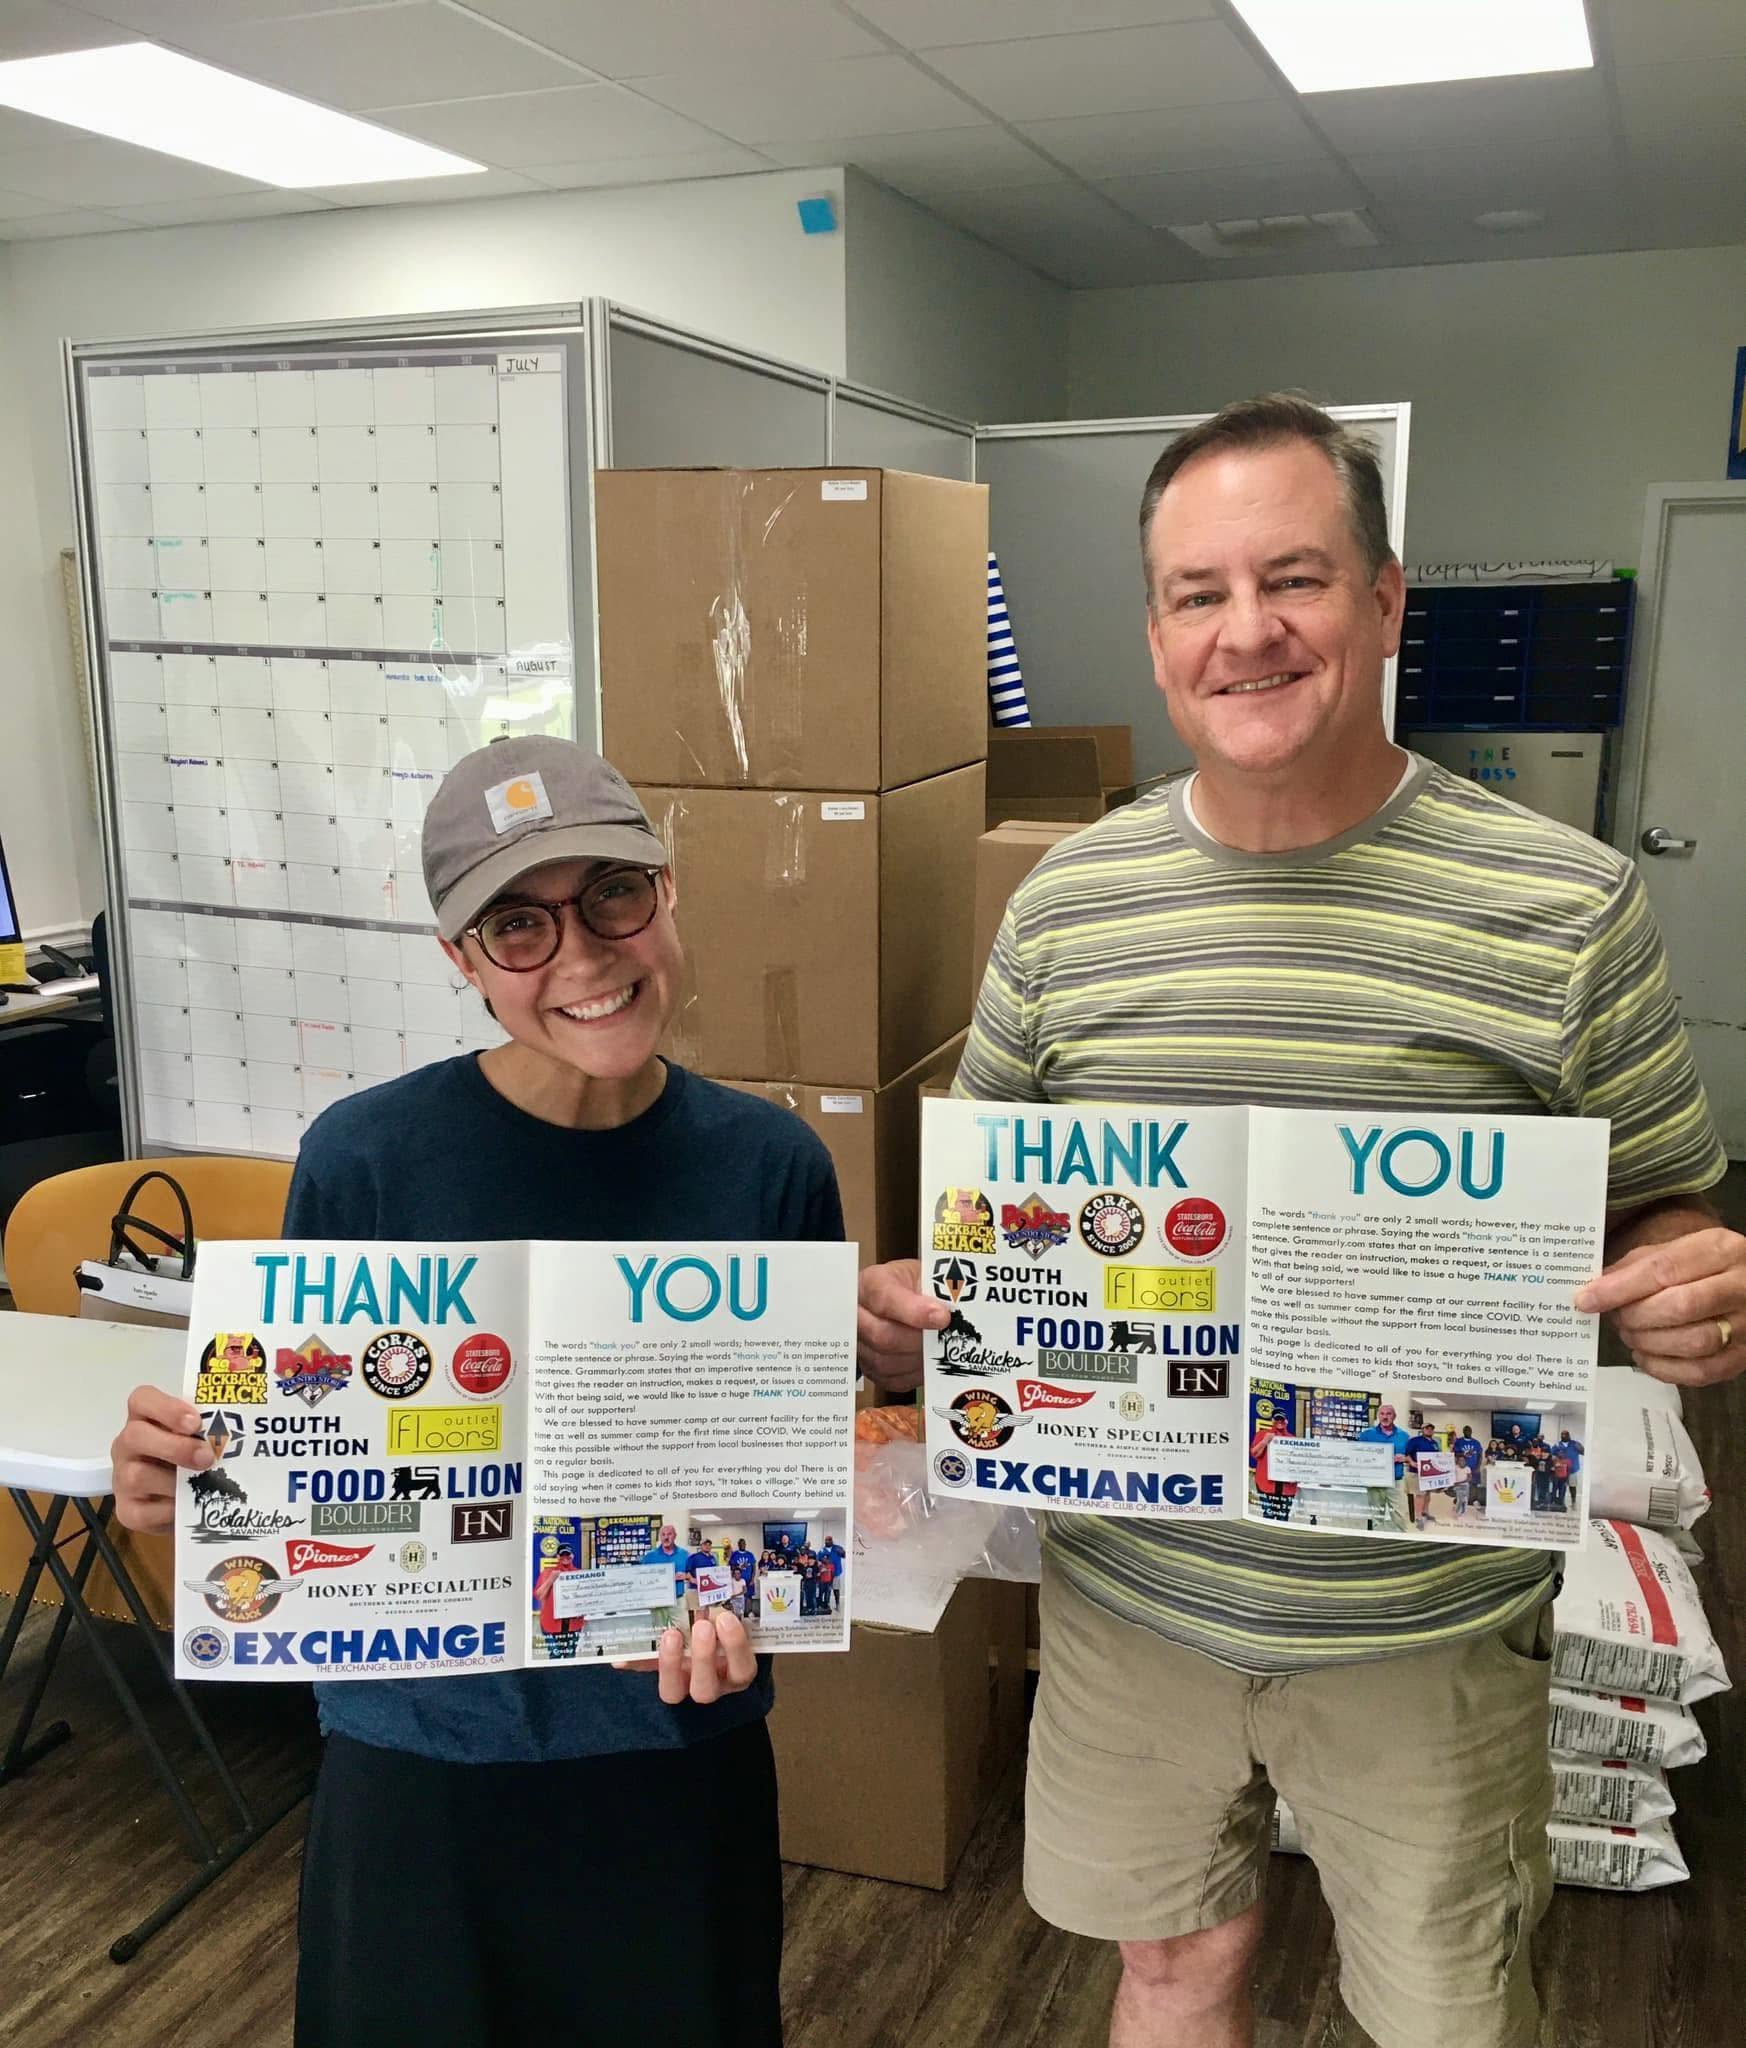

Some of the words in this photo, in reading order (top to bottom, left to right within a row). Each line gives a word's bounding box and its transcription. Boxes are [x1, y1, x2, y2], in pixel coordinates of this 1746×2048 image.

[506, 357, 538, 373] JULY
[516, 660, 557, 673] AUGUST
[1469, 747, 1511, 761] THE
[1469, 767, 1517, 781] BOSS
[974, 1114, 1190, 1188] THANK
[1335, 1122, 1505, 1199] YOU
[1084, 1194, 1140, 1219] CORKS
[934, 1222, 996, 1237] KICKBACK
[933, 1236, 996, 1254] SHACK
[1087, 1234, 1116, 1254] SINCE
[1118, 1236, 1138, 1253] 2004
[1251, 1245, 1267, 1253] that
[1269, 1249, 1292, 1257] gives
[1294, 1249, 1308, 1257] the
[1311, 1250, 1342, 1259] reader
[1359, 1254, 1407, 1264] instruction,
[1410, 1255, 1439, 1264] makes
[1451, 1259, 1489, 1268] request,
[1505, 1260, 1532, 1269] issues
[1544, 1264, 1594, 1272] command.
[985, 1265, 1062, 1285] SOUTH
[1158, 1271, 1211, 1286] outlet
[252, 1252, 479, 1325] THANK
[613, 1253, 768, 1324] YOU
[985, 1287, 1088, 1308] AUCTION
[1114, 1271, 1209, 1307] floors
[1250, 1308, 1272, 1318] make
[1274, 1311, 1290, 1319] this
[1290, 1312, 1328, 1324] possible
[1330, 1316, 1363, 1325] without
[1364, 1318, 1379, 1326] the
[1381, 1320, 1417, 1330] support
[1419, 1321, 1442, 1330] from
[1443, 1322, 1466, 1331] local
[1468, 1324, 1517, 1334] businesses
[1519, 1327, 1539, 1335] that
[1540, 1330, 1578, 1339] support
[1016, 1316, 1104, 1351] FOOD
[1163, 1324, 1240, 1356] LION
[367, 1334, 428, 1359] CORKS
[948, 1346, 1034, 1368] ColaKicks
[1045, 1352, 1130, 1375] BOULDER
[968, 1364, 1011, 1374] SAVANNAH
[198, 1373, 268, 1386] KICKBACK
[369, 1376, 400, 1396] SINCE
[403, 1375, 425, 1394] 2004
[1176, 1367, 1224, 1392] HN
[195, 1386, 268, 1404] SHACK
[556, 1392, 573, 1400] that
[576, 1392, 601, 1402] being
[603, 1392, 624, 1402] said,
[642, 1391, 667, 1399] would
[729, 1389, 749, 1399] huge
[753, 1389, 782, 1397] THANK
[786, 1388, 806, 1397] YOU
[965, 1391, 999, 1404] WING
[1023, 1384, 1083, 1408] Pioneer
[254, 1416, 341, 1434] SOUTH
[444, 1413, 498, 1427] outlet
[396, 1414, 497, 1450] floors
[1037, 1423, 1099, 1438] HONEY
[1106, 1428, 1230, 1444] SPECIALTIES
[253, 1439, 369, 1457] AUCTION
[967, 1438, 999, 1449] MAXX
[1280, 1439, 1321, 1448] EXCHANGE
[1662, 1454, 1673, 1478] Sysco
[287, 1468, 386, 1503] FOOD
[447, 1462, 523, 1501] LION
[975, 1457, 1224, 1506] EXCHANGE
[1427, 1478, 1450, 1487] TIME
[533, 1495, 565, 1504] blessed
[579, 1495, 600, 1503] have
[619, 1492, 657, 1503] "village"
[672, 1490, 718, 1499] Statesboro
[740, 1489, 769, 1497] Bulloch
[772, 1489, 801, 1498] County
[804, 1488, 833, 1497] behind
[1047, 1496, 1061, 1505] THE
[1063, 1498, 1111, 1510] EXCHANGE
[1112, 1502, 1135, 1511] CLUB
[1136, 1503, 1148, 1512] OF
[1150, 1504, 1207, 1515] STATESBORO,
[1209, 1506, 1223, 1514] GA
[206, 1508, 306, 1528] ColaKicks
[319, 1505, 413, 1527] BOULDER
[461, 1509, 506, 1538] HN
[230, 1528, 280, 1536] SAVANNAH
[224, 1558, 263, 1571] WING
[565, 1571, 606, 1581] EXCHANGE
[307, 1584, 377, 1598] HONEY
[385, 1576, 513, 1596] SPECIALTIES
[225, 1609, 262, 1621] MAXX
[234, 1622, 505, 1665] EXCHANGE
[316, 1664, 334, 1673] THE
[335, 1663, 387, 1672] EXCHANGE
[389, 1662, 413, 1671] CLUB
[414, 1661, 428, 1670] OF
[430, 1656, 488, 1669] STATESBORO,
[490, 1656, 505, 1665] GA
